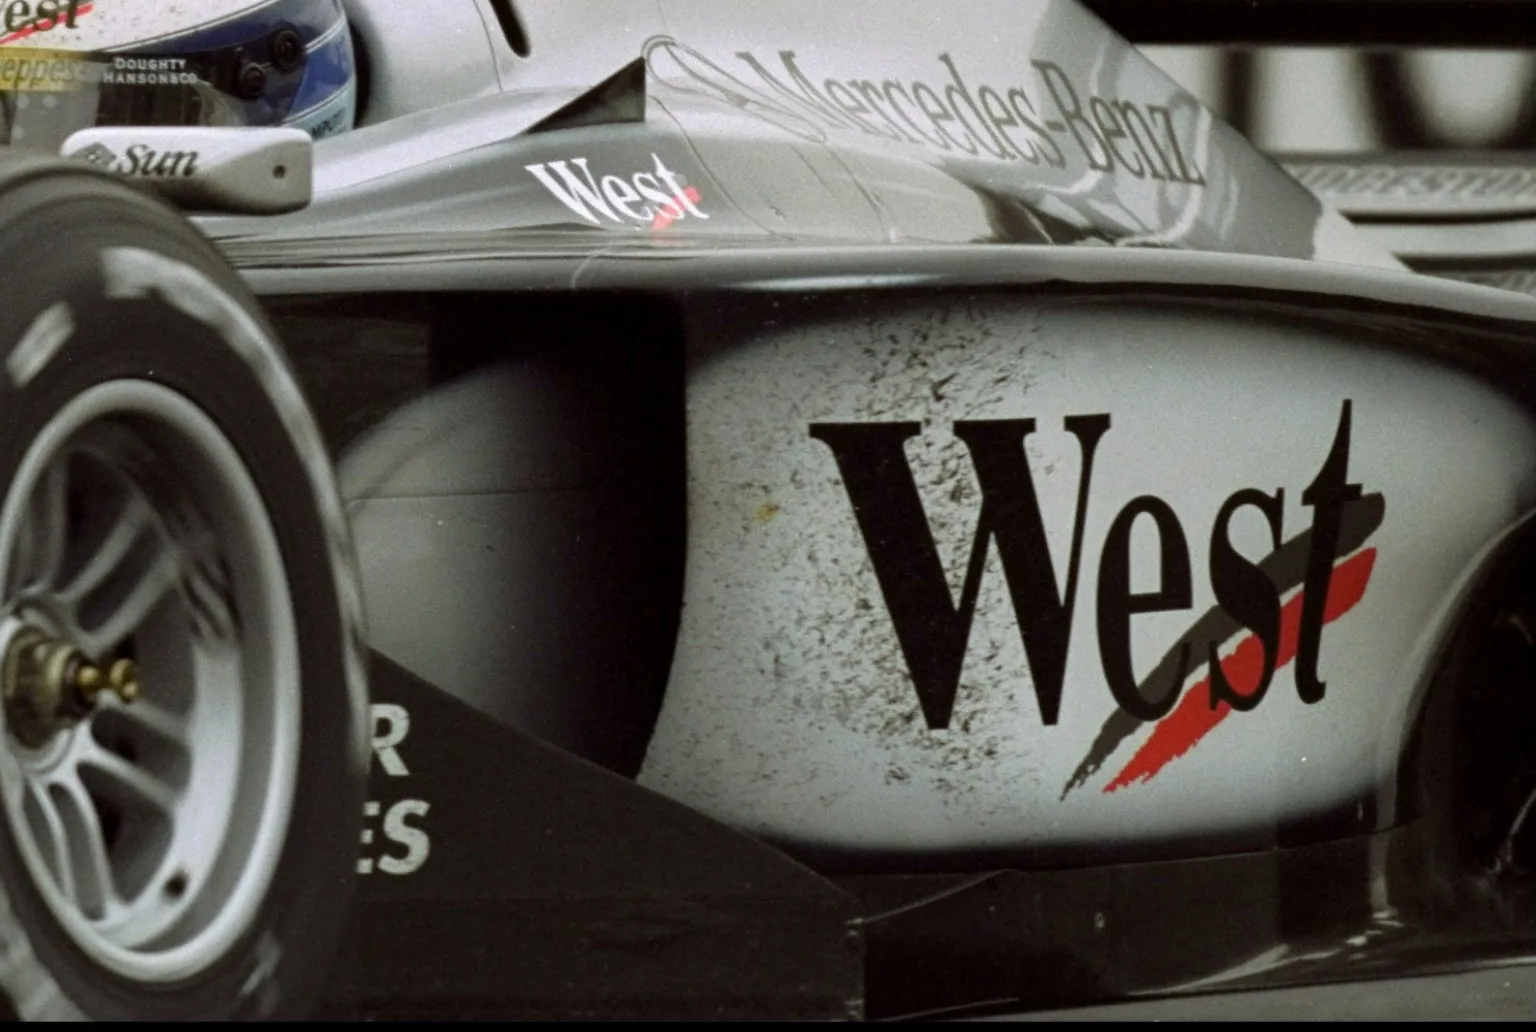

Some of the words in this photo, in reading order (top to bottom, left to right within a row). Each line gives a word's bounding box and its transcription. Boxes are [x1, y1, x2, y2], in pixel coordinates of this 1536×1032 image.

[115, 57, 186, 69] DOUGHTY
[736, 50, 1206, 186] Mercedes-Benz
[118, 143, 200, 176] Sun
[524, 152, 710, 224] West
[808, 399, 1366, 731] West
